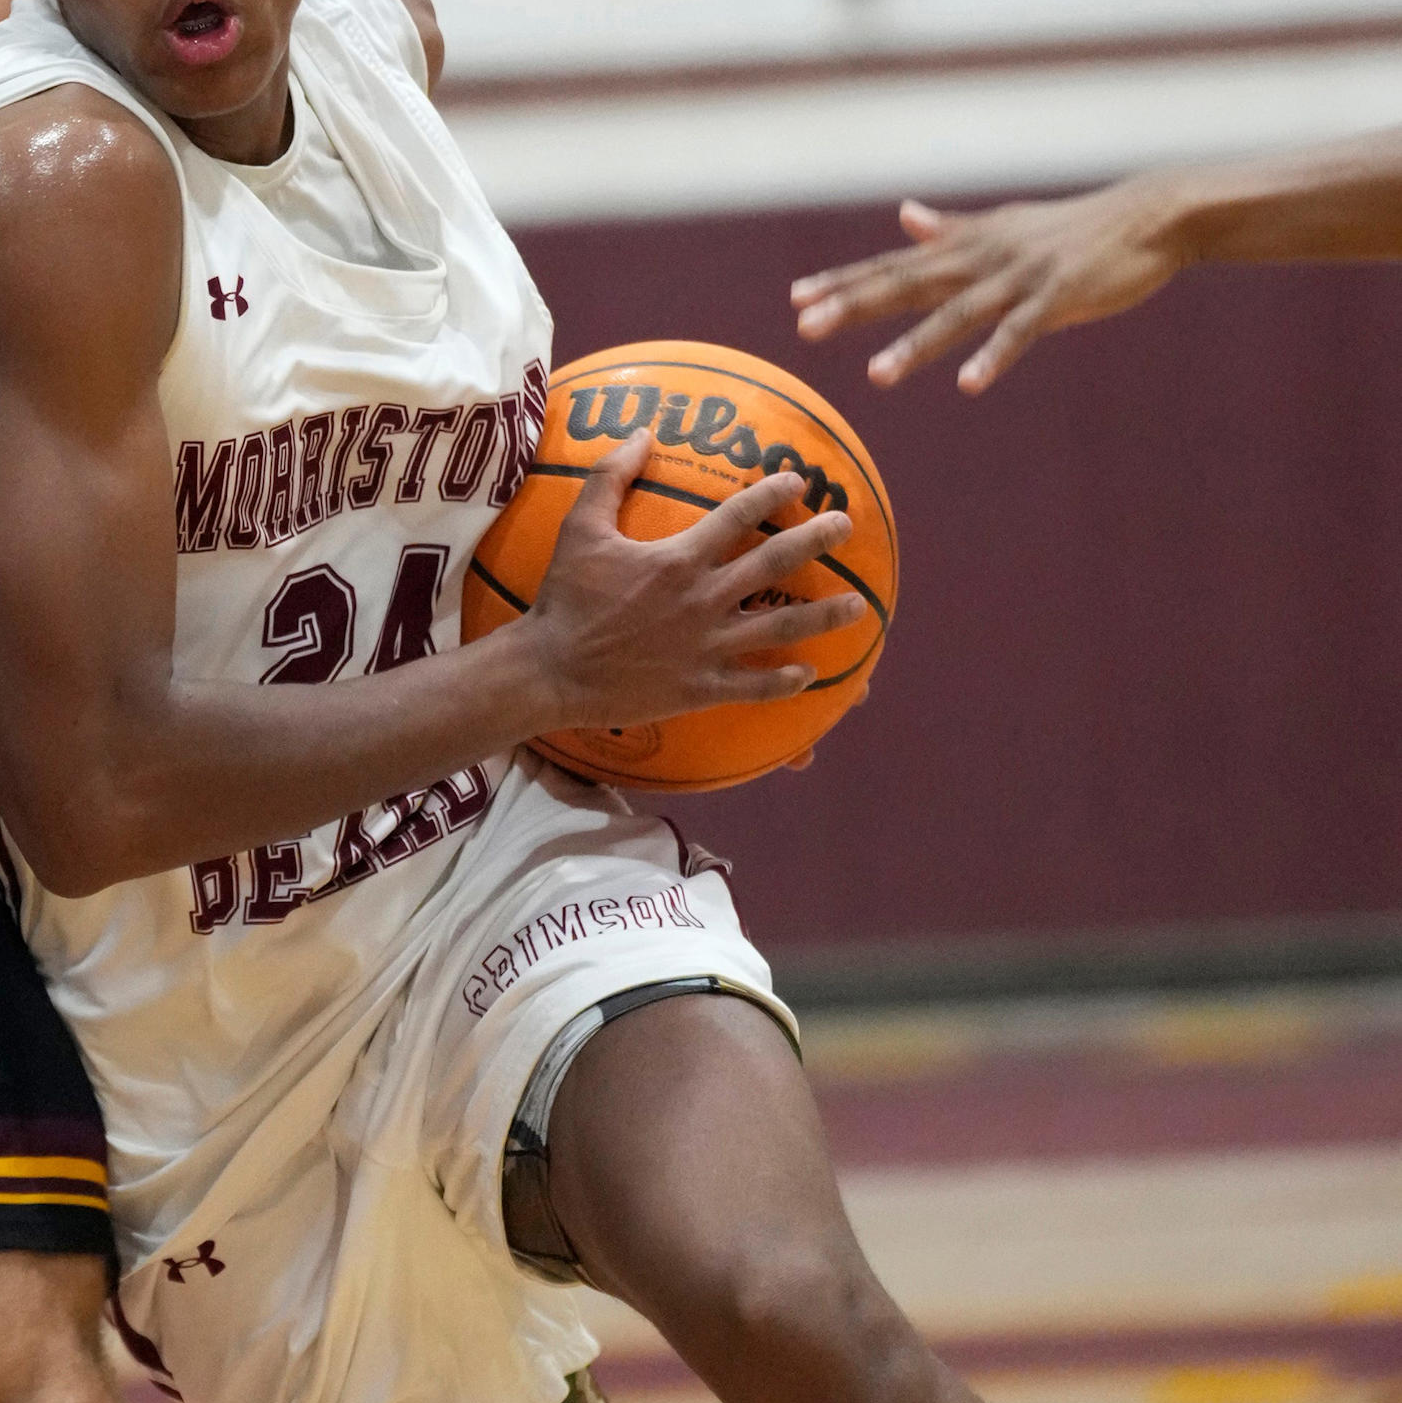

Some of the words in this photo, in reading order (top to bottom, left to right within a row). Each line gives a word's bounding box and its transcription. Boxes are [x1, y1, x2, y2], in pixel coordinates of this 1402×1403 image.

[566, 384, 849, 515] Wilson
[258, 543, 451, 685] 24
[462, 882, 706, 1019] CRIMSON
